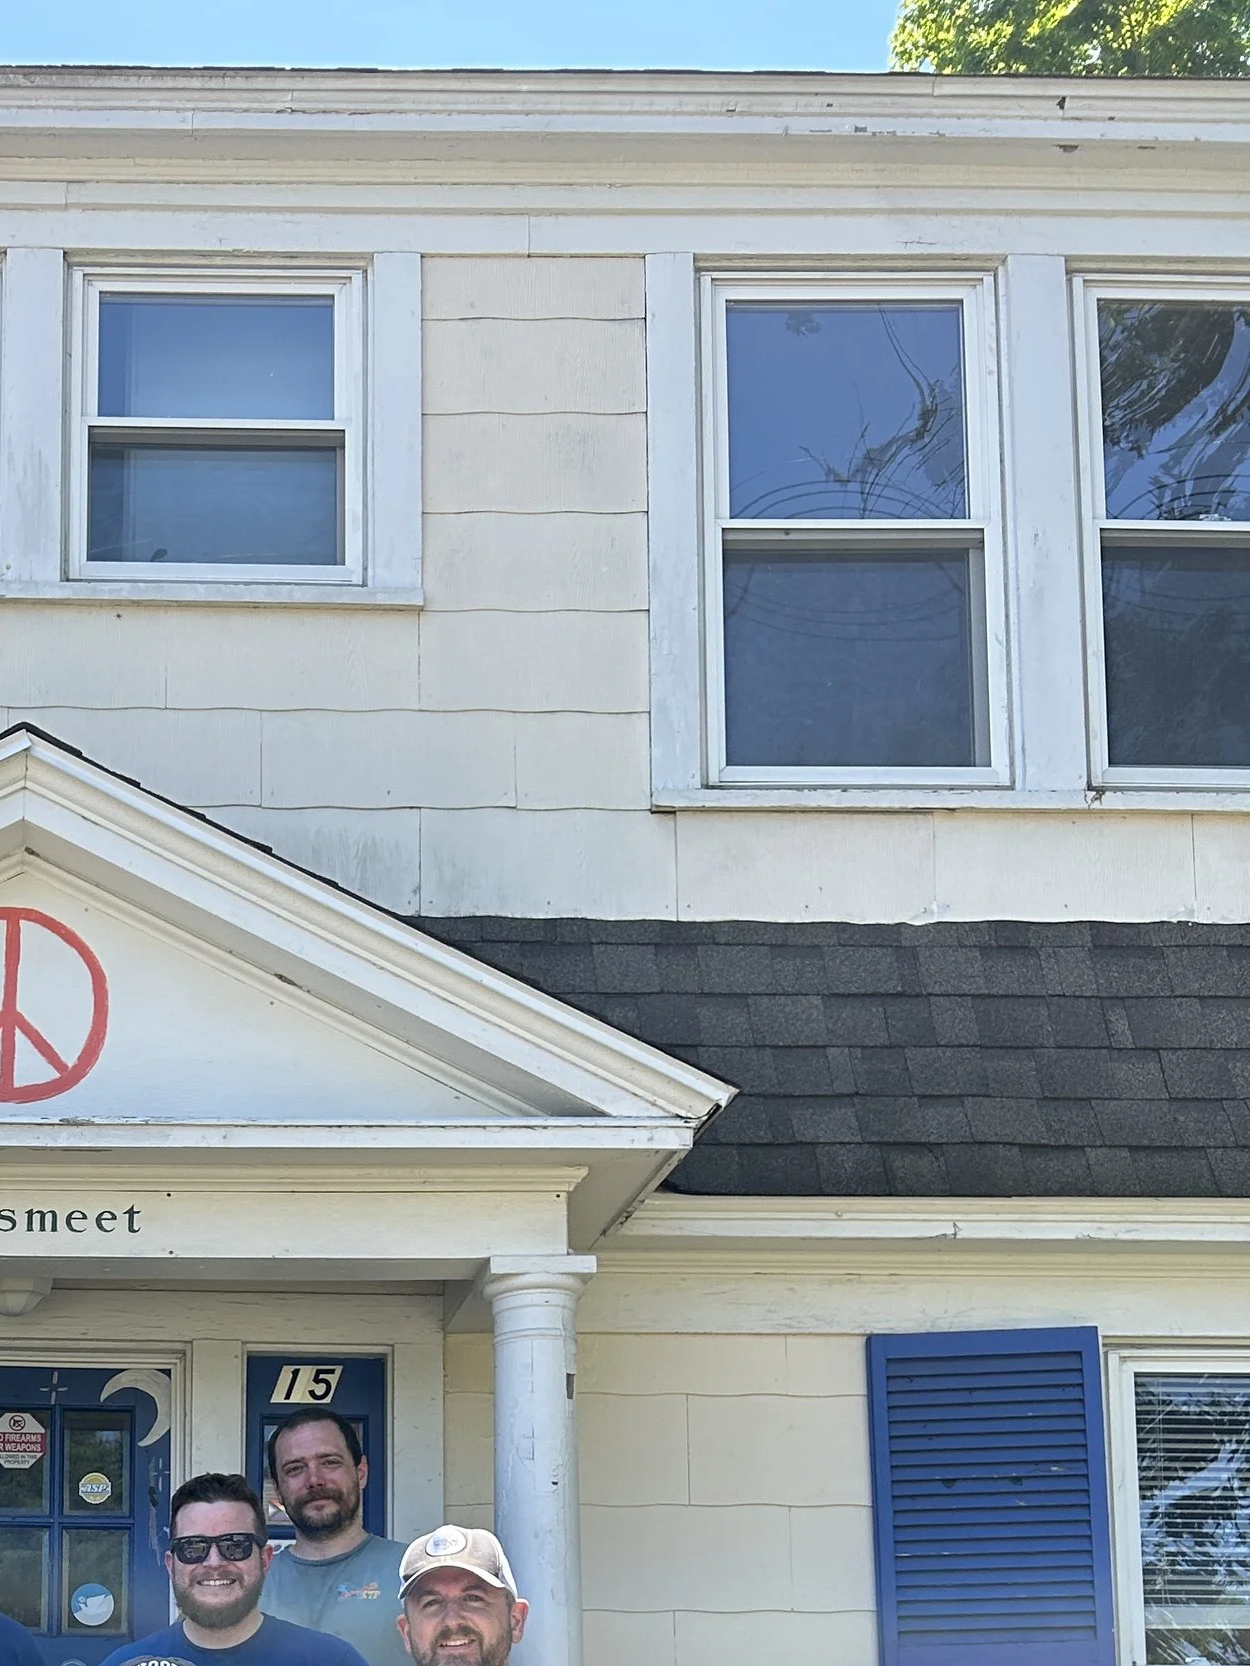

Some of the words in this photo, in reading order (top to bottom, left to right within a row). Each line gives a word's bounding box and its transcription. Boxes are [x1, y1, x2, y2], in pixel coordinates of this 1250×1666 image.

[284, 1368, 336, 1401] 15
[5, 1433, 42, 1443] FIREARMS
[5, 1443, 41, 1452] WEAPONS
